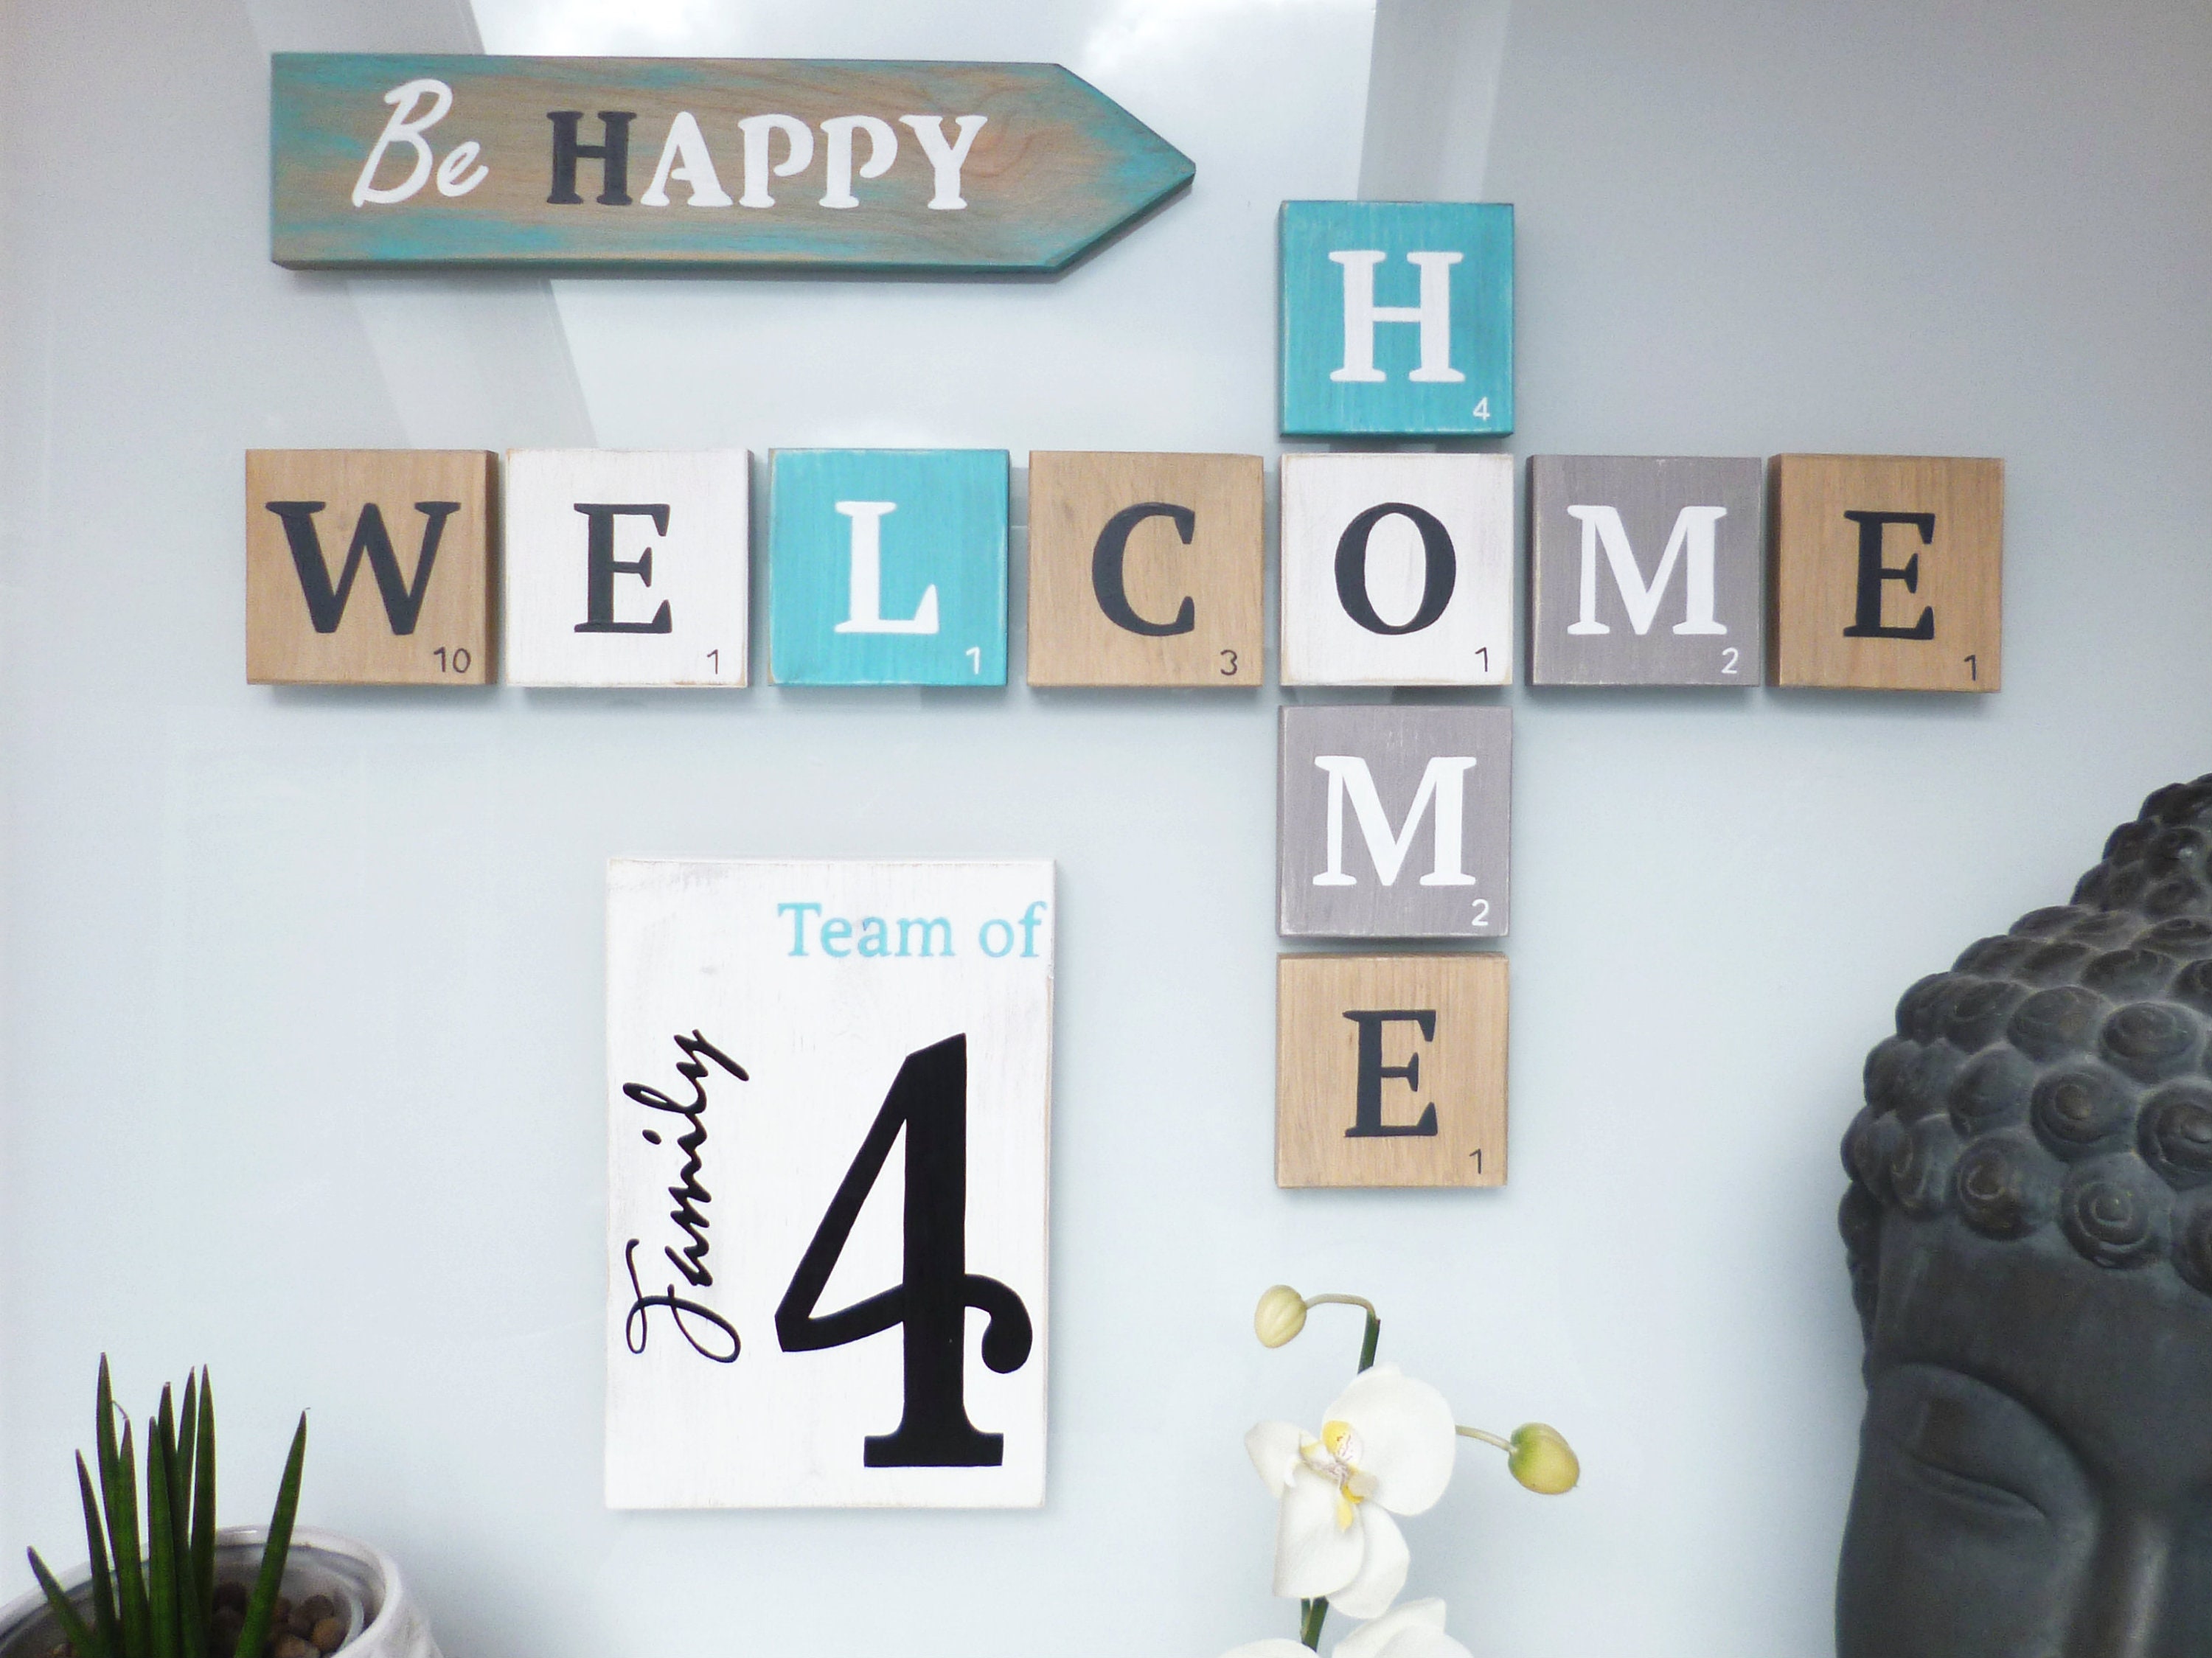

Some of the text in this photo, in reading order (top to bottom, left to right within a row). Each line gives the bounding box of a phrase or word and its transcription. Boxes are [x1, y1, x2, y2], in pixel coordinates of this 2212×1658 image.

[352, 77, 988, 211] Be HAPPY
[1472, 397, 1490, 420] 4
[432, 647, 472, 675] 10
[706, 648, 721, 675] 1
[965, 647, 981, 674] 1
[1220, 649, 1239, 676] 3
[1475, 647, 1489, 673] 1
[1720, 647, 1739, 675] 2
[1963, 654, 1978, 681] 1
[1470, 898, 1489, 927] 2
[777, 901, 1046, 958] Team of
[1469, 1149, 1483, 1174] 1
[622, 1028, 749, 1363] Family
[774, 1032, 1033, 1467] 4
